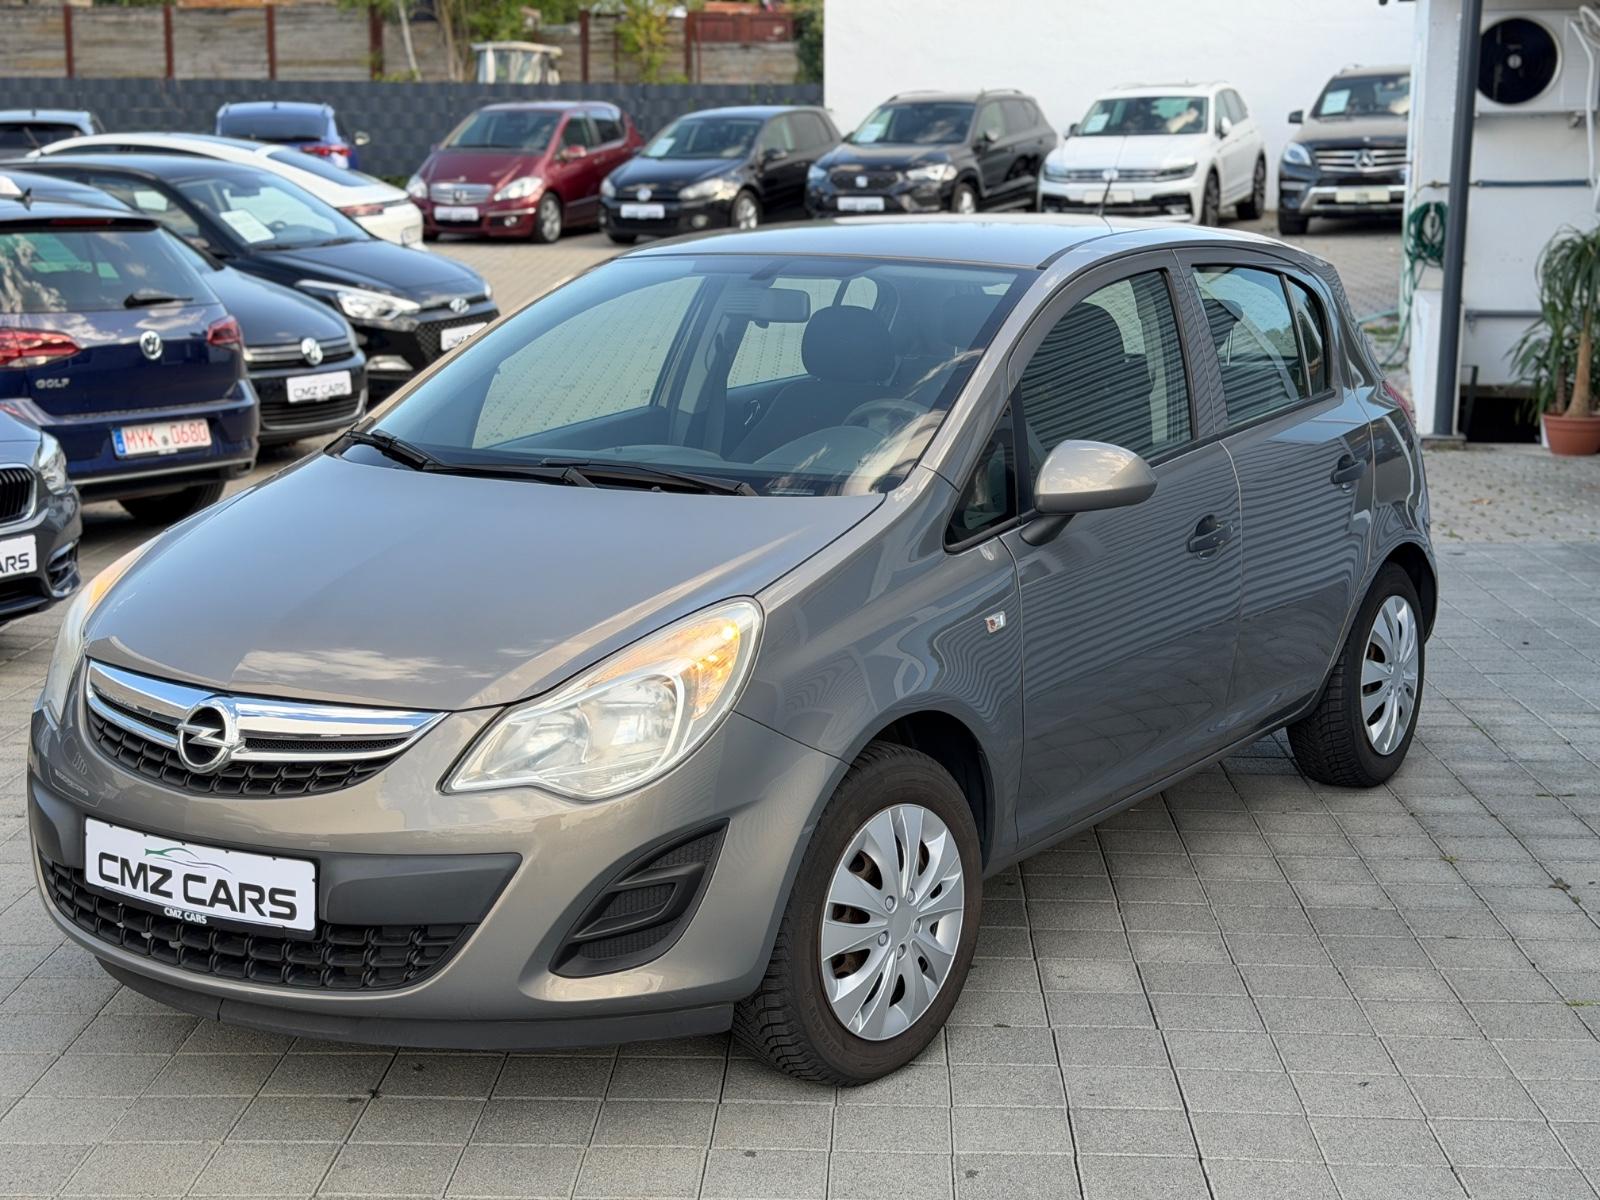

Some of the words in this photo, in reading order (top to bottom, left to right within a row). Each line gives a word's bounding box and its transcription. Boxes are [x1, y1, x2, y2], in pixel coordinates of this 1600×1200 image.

[35, 378, 70, 389] GOLF
[125, 427, 157, 450] MYK
[170, 422, 208, 443] 0680
[98, 851, 173, 898] CMZ
[183, 872, 298, 921] CARS
[164, 907, 183, 920] CMZ
[184, 910, 207, 925] CARS
